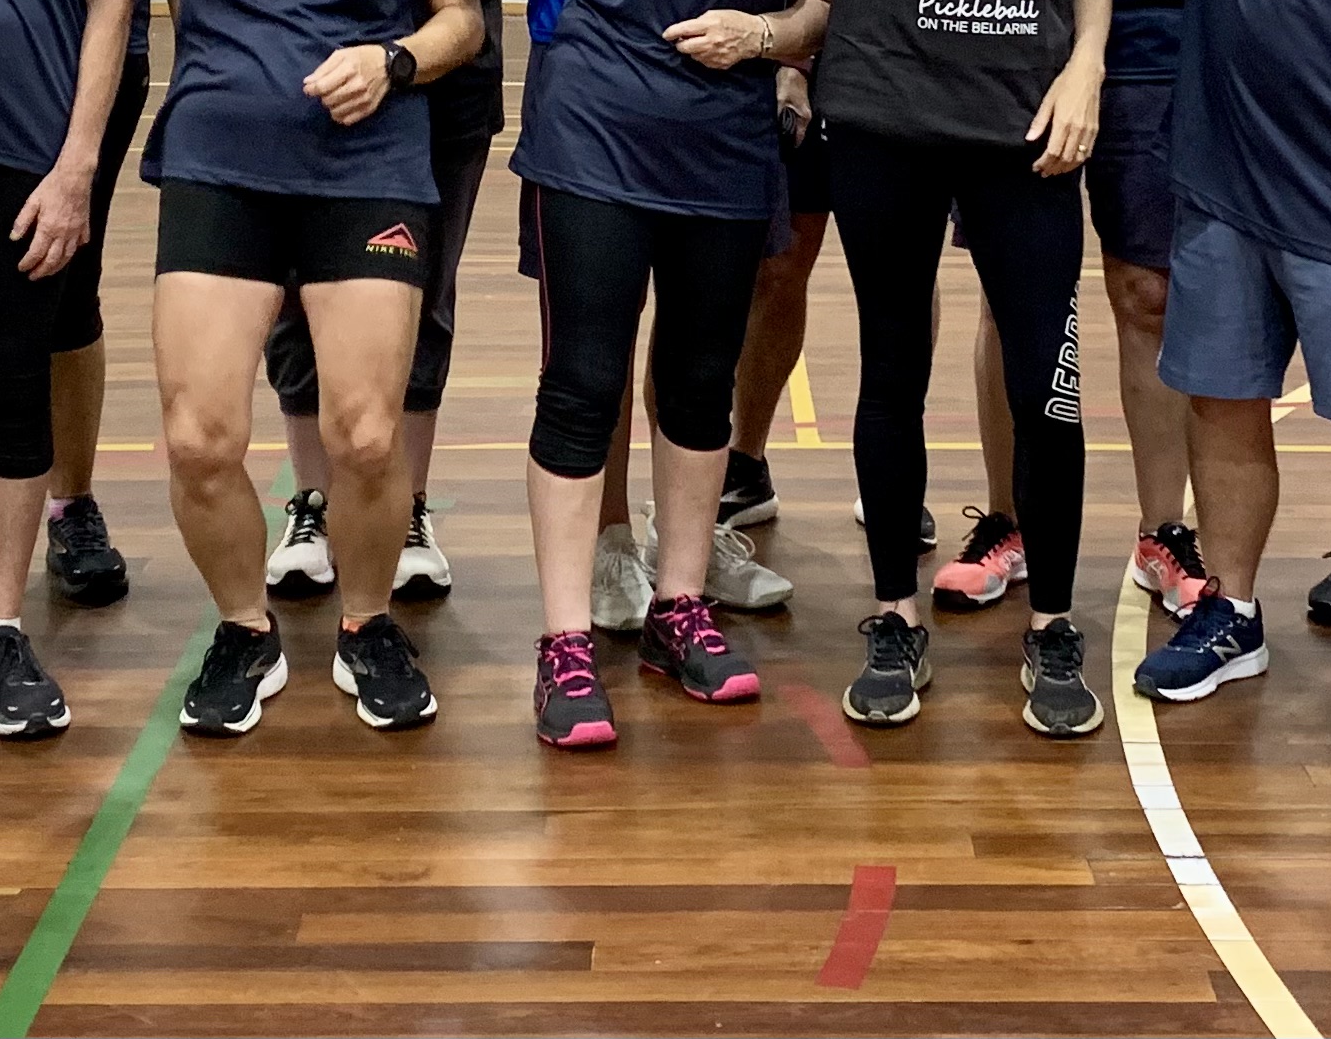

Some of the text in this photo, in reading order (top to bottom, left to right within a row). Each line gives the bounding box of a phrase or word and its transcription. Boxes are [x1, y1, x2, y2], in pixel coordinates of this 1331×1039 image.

[917, 17, 1039, 35] ON THE BELLARINE
